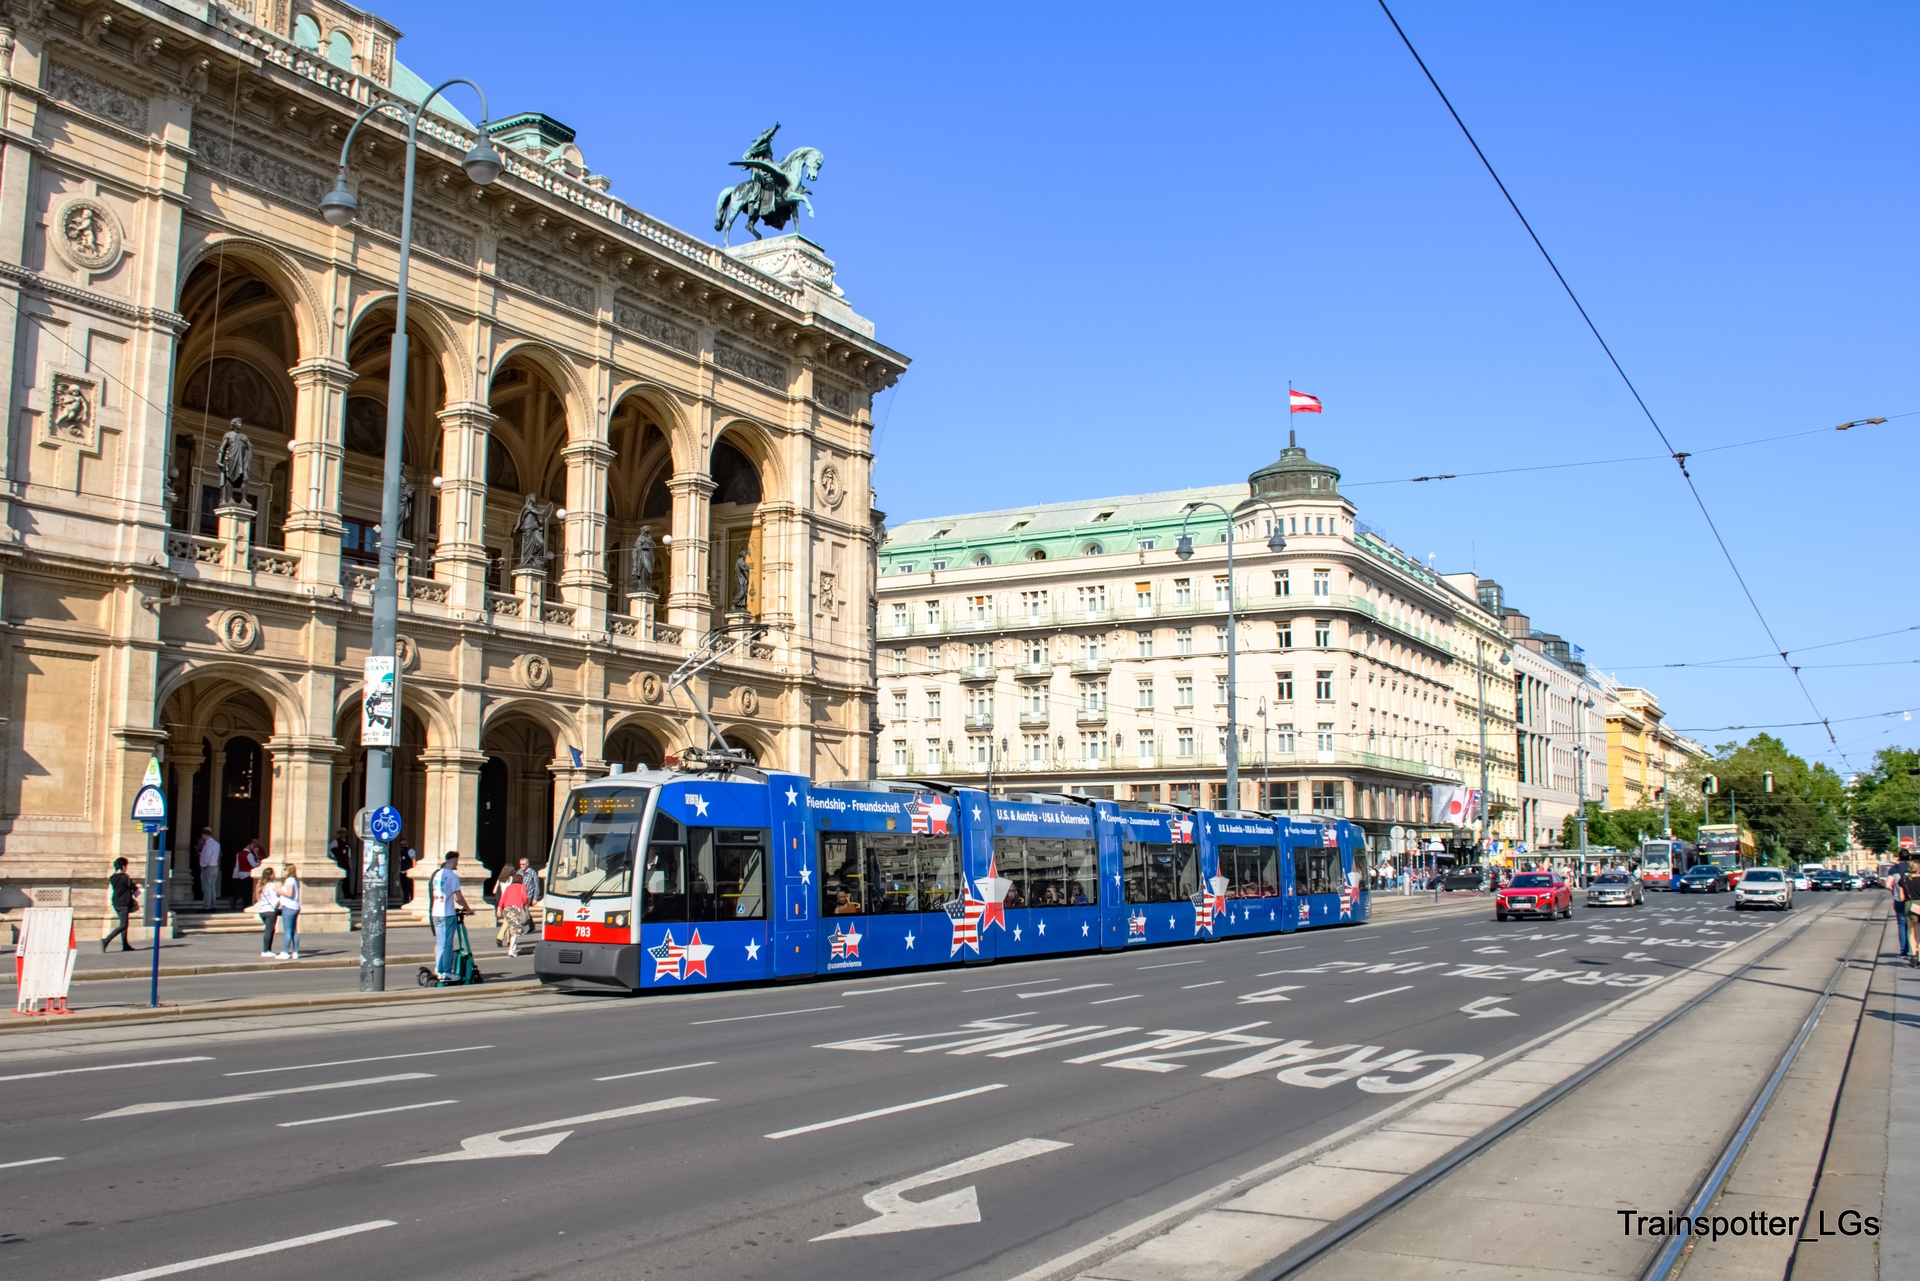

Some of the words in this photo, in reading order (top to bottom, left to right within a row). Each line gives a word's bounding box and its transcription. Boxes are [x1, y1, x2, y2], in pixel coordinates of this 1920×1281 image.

[685, 794, 699, 805] 783
[806, 795, 846, 813] Friendship
[852, 800, 900, 813] Freundschaft
[996, 809, 1010, 820] U.S.
[1010, 810, 1015, 820] &
[1016, 811, 1039, 822] Austria
[1042, 812, 1055, 823] USA
[1055, 813, 1060, 823] &
[1060, 811, 1090, 825] Österreich
[1255, 824, 1274, 834] Österreich
[575, 926, 591, 938] 783
[1600, 936, 1737, 948] GRAZ
[1283, 961, 1490, 976] LINZ
[1461, 966, 1664, 987] GRAZ
[815, 1022, 1208, 1064] LINZ
[1101, 1033, 1484, 1093] GRAZ
